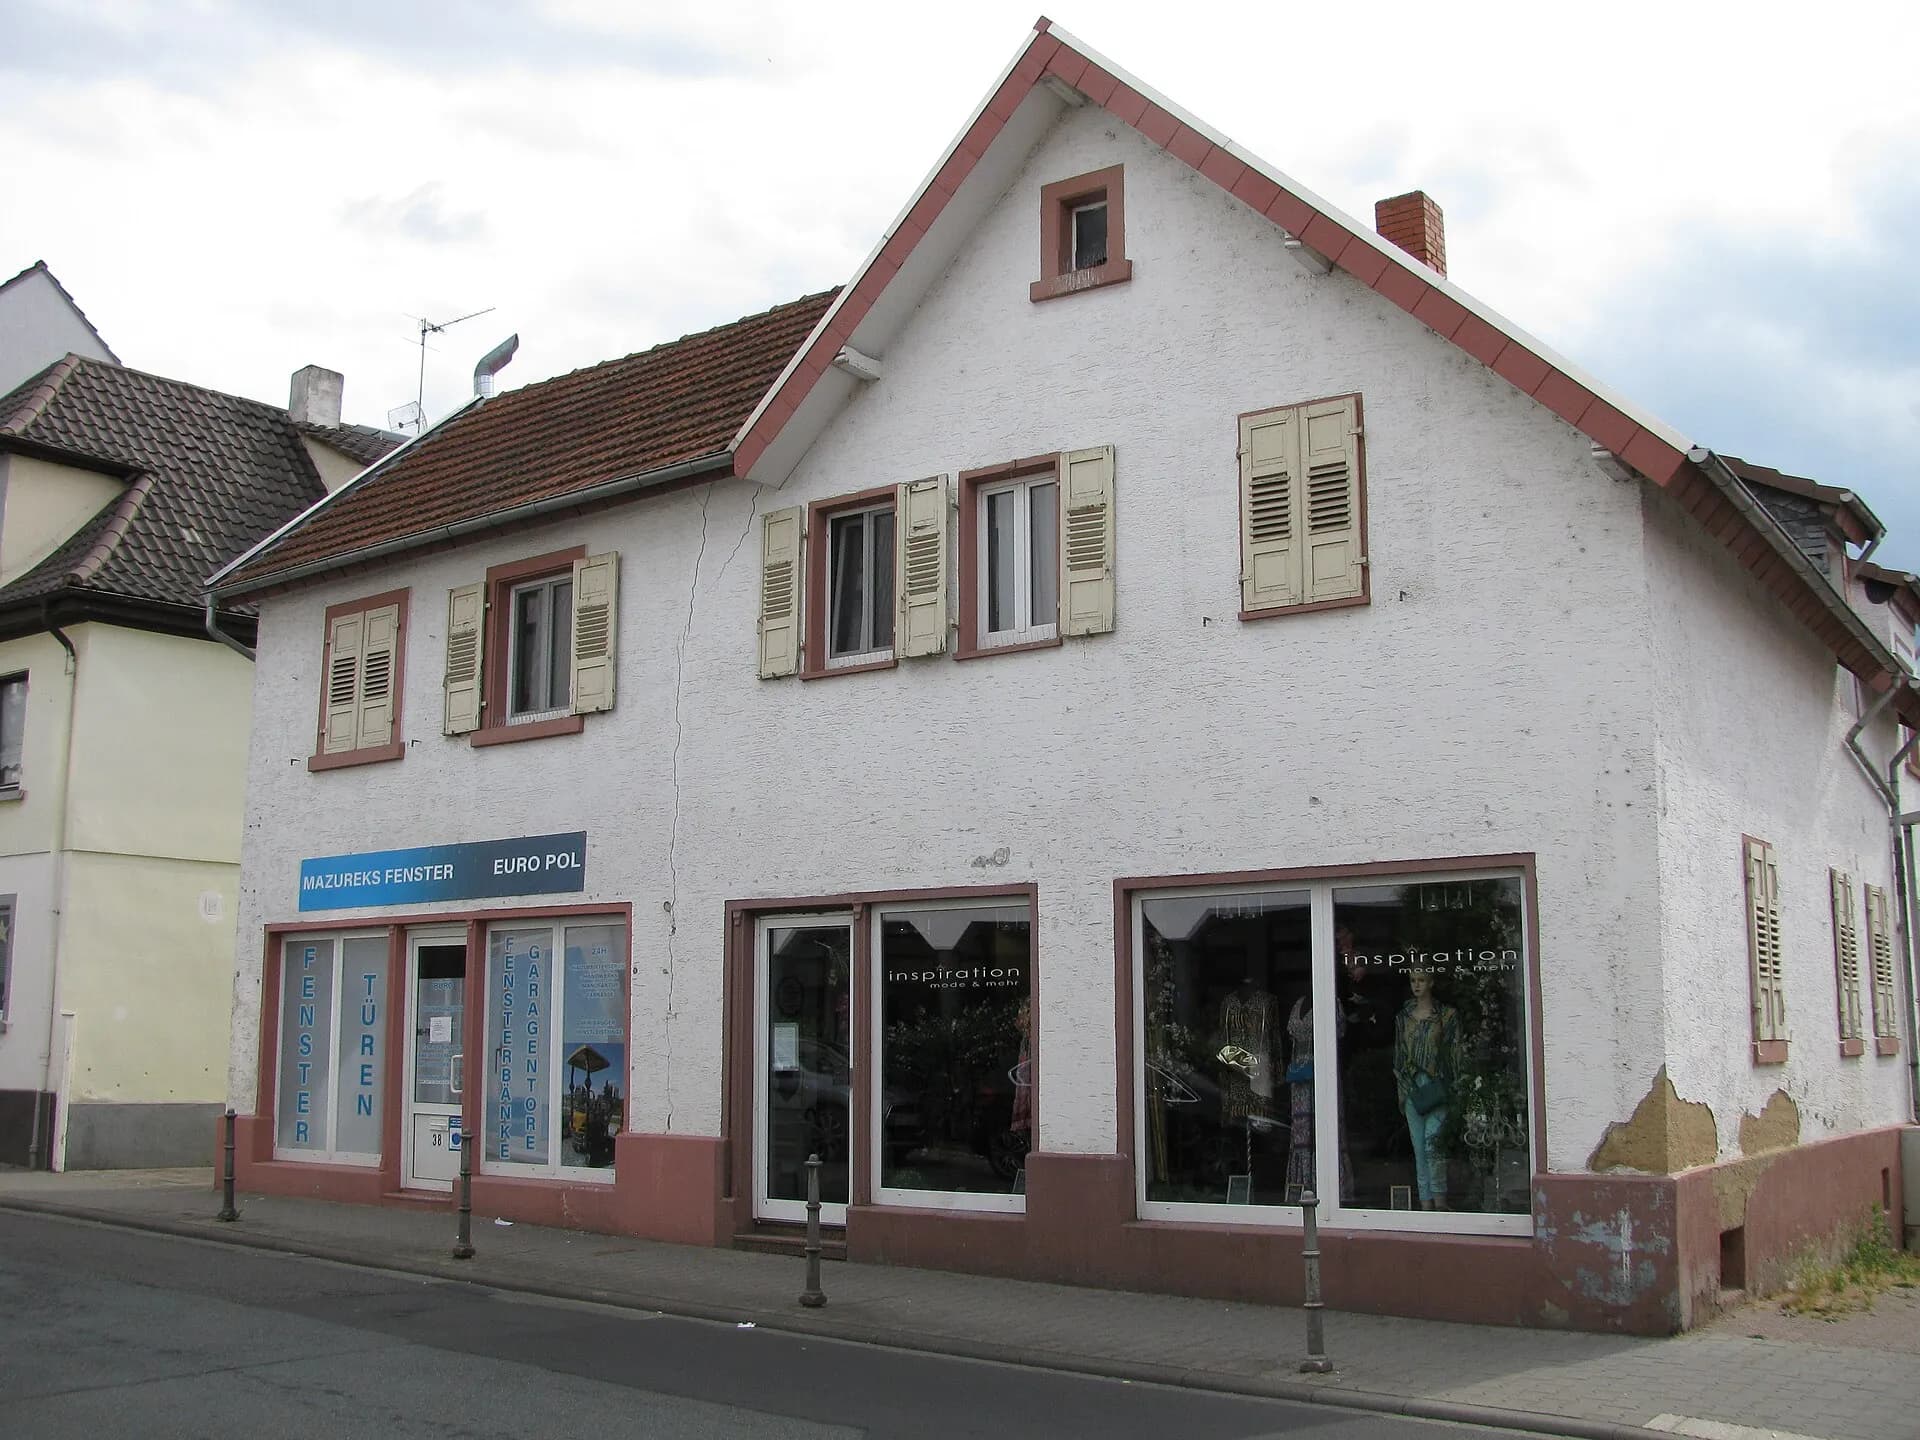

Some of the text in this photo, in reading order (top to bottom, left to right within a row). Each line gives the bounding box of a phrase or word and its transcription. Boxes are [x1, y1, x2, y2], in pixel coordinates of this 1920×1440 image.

[494, 851, 582, 876] EURO POL
[303, 863, 455, 891] MAZUREKS FENSTER
[1343, 948, 1518, 967] inspiration
[1398, 963, 1517, 974] mode & mehr
[888, 966, 1021, 983] inspiration
[929, 979, 1019, 989] mode & mehr
[295, 947, 316, 1143] FENSTER
[357, 973, 377, 1117] TÜREN
[525, 944, 540, 1150] GARAGENTORE
[432, 1133, 442, 1146] 38
